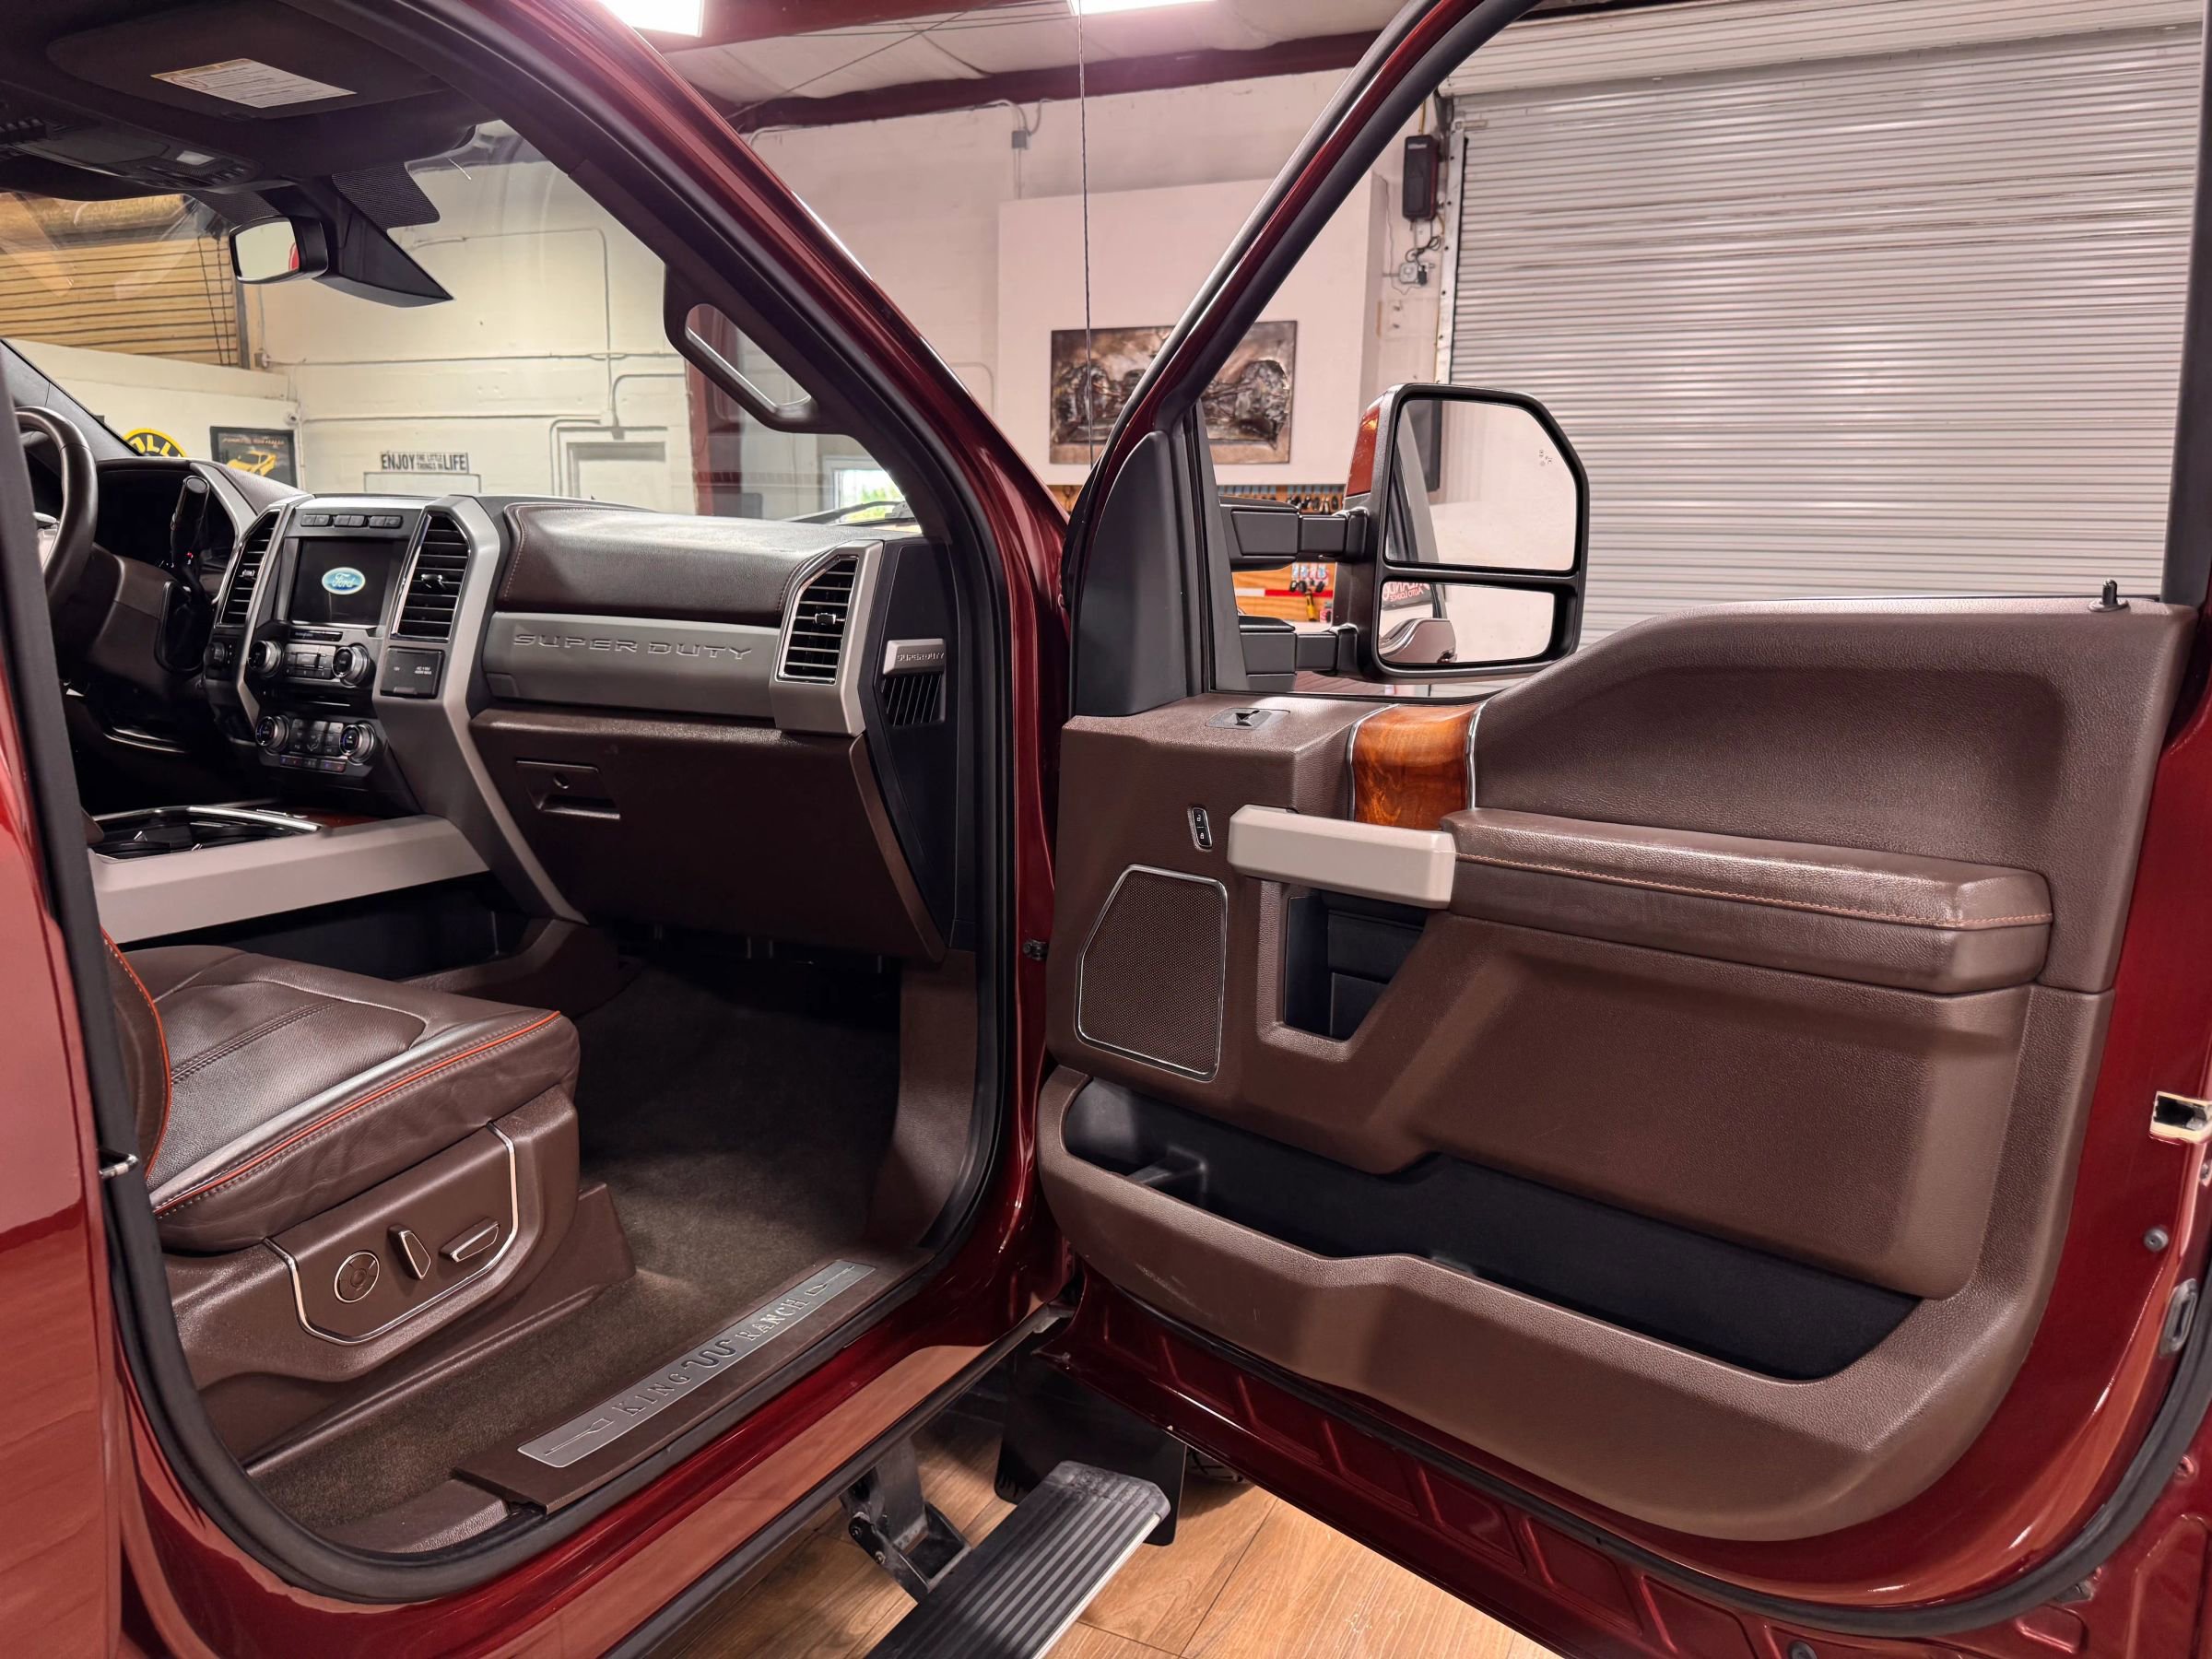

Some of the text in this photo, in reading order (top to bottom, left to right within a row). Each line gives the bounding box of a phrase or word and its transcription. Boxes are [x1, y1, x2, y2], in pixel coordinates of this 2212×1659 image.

[381, 453, 415, 470] ENJOY
[443, 454, 466, 471] LIFE
[332, 572, 357, 588] Ford
[513, 634, 752, 660] SUPER DUTY
[897, 652, 945, 662] SUPER DUTY
[735, 1297, 808, 1342] RANCH
[611, 1372, 691, 1417] KING
